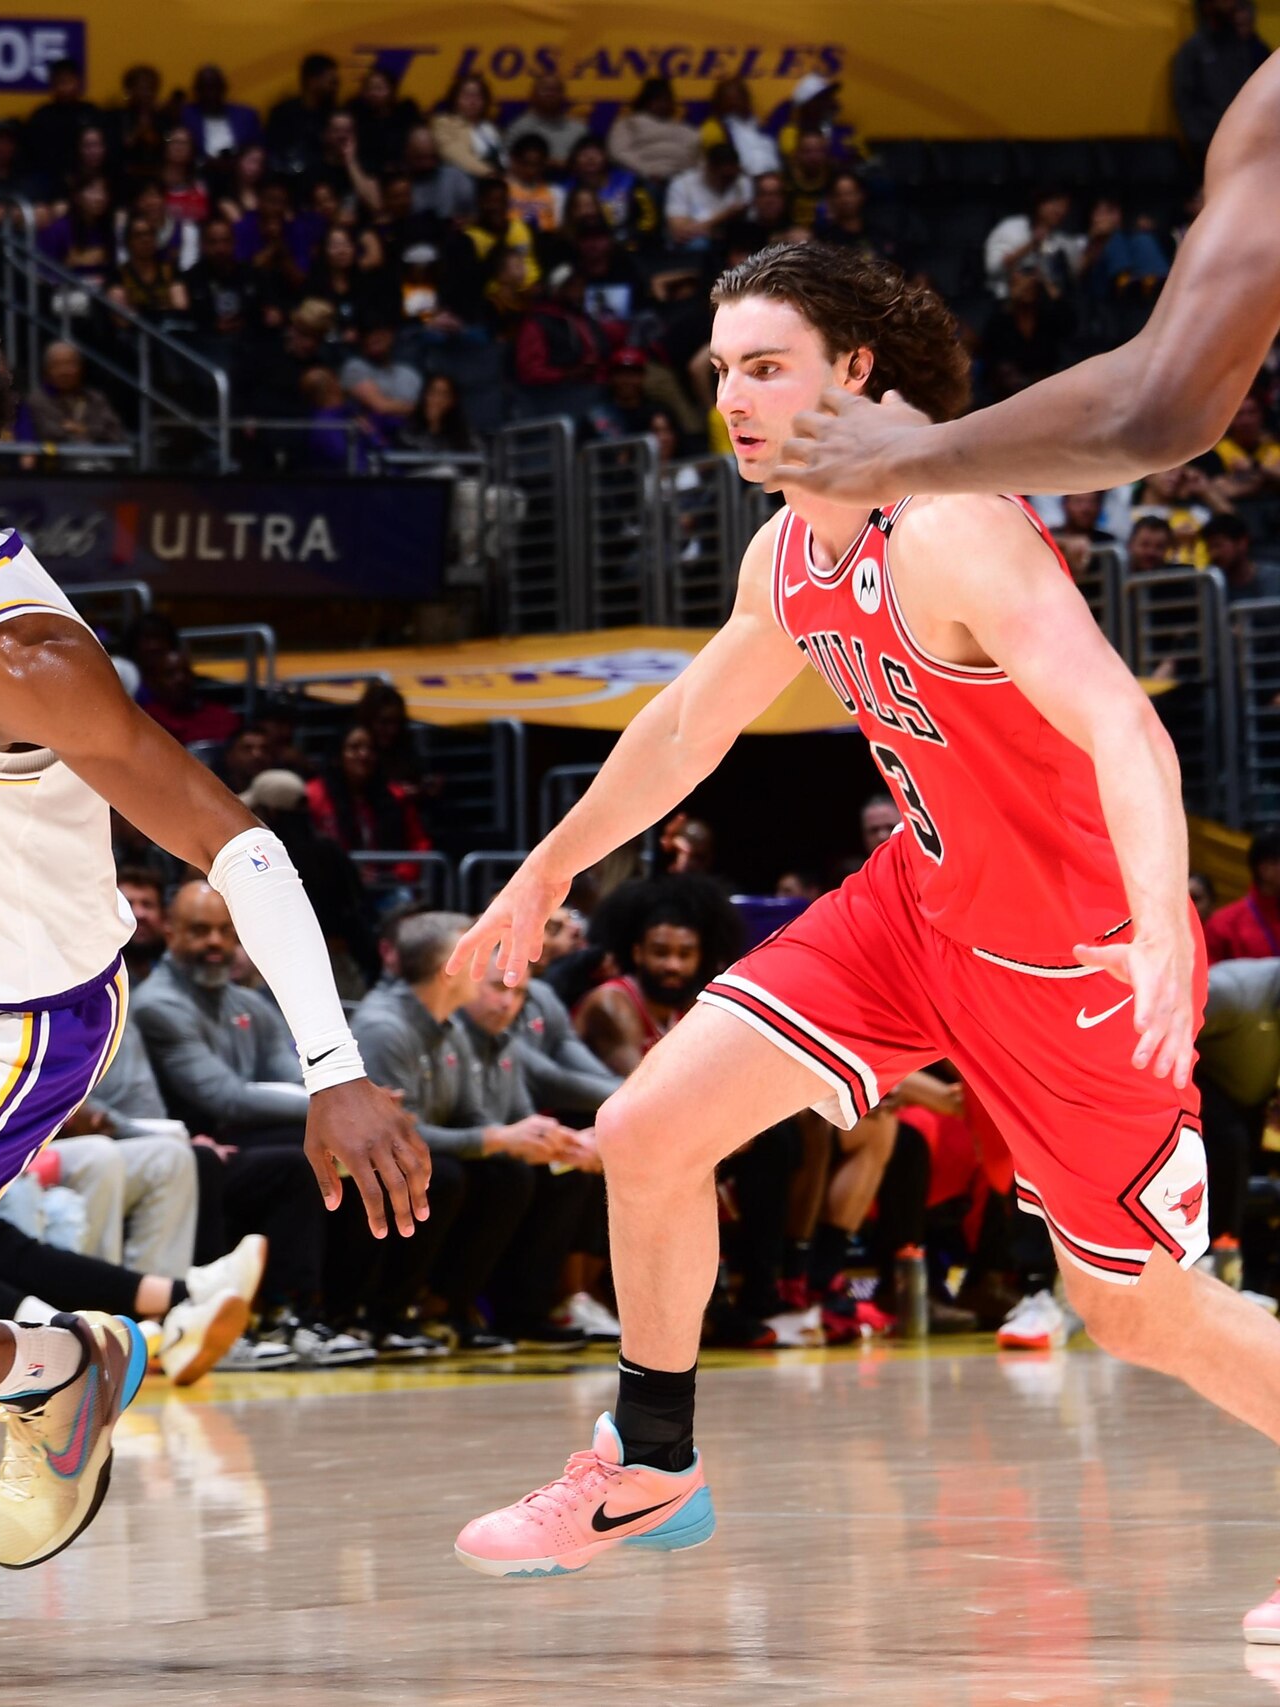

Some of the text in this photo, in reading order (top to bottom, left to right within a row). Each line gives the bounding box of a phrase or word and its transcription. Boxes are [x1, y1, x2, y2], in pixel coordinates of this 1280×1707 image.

[457, 46, 561, 80] LOS
[573, 46, 847, 80] ANGELES
[151, 511, 340, 563] ULTRA
[870, 741, 944, 866] 3
